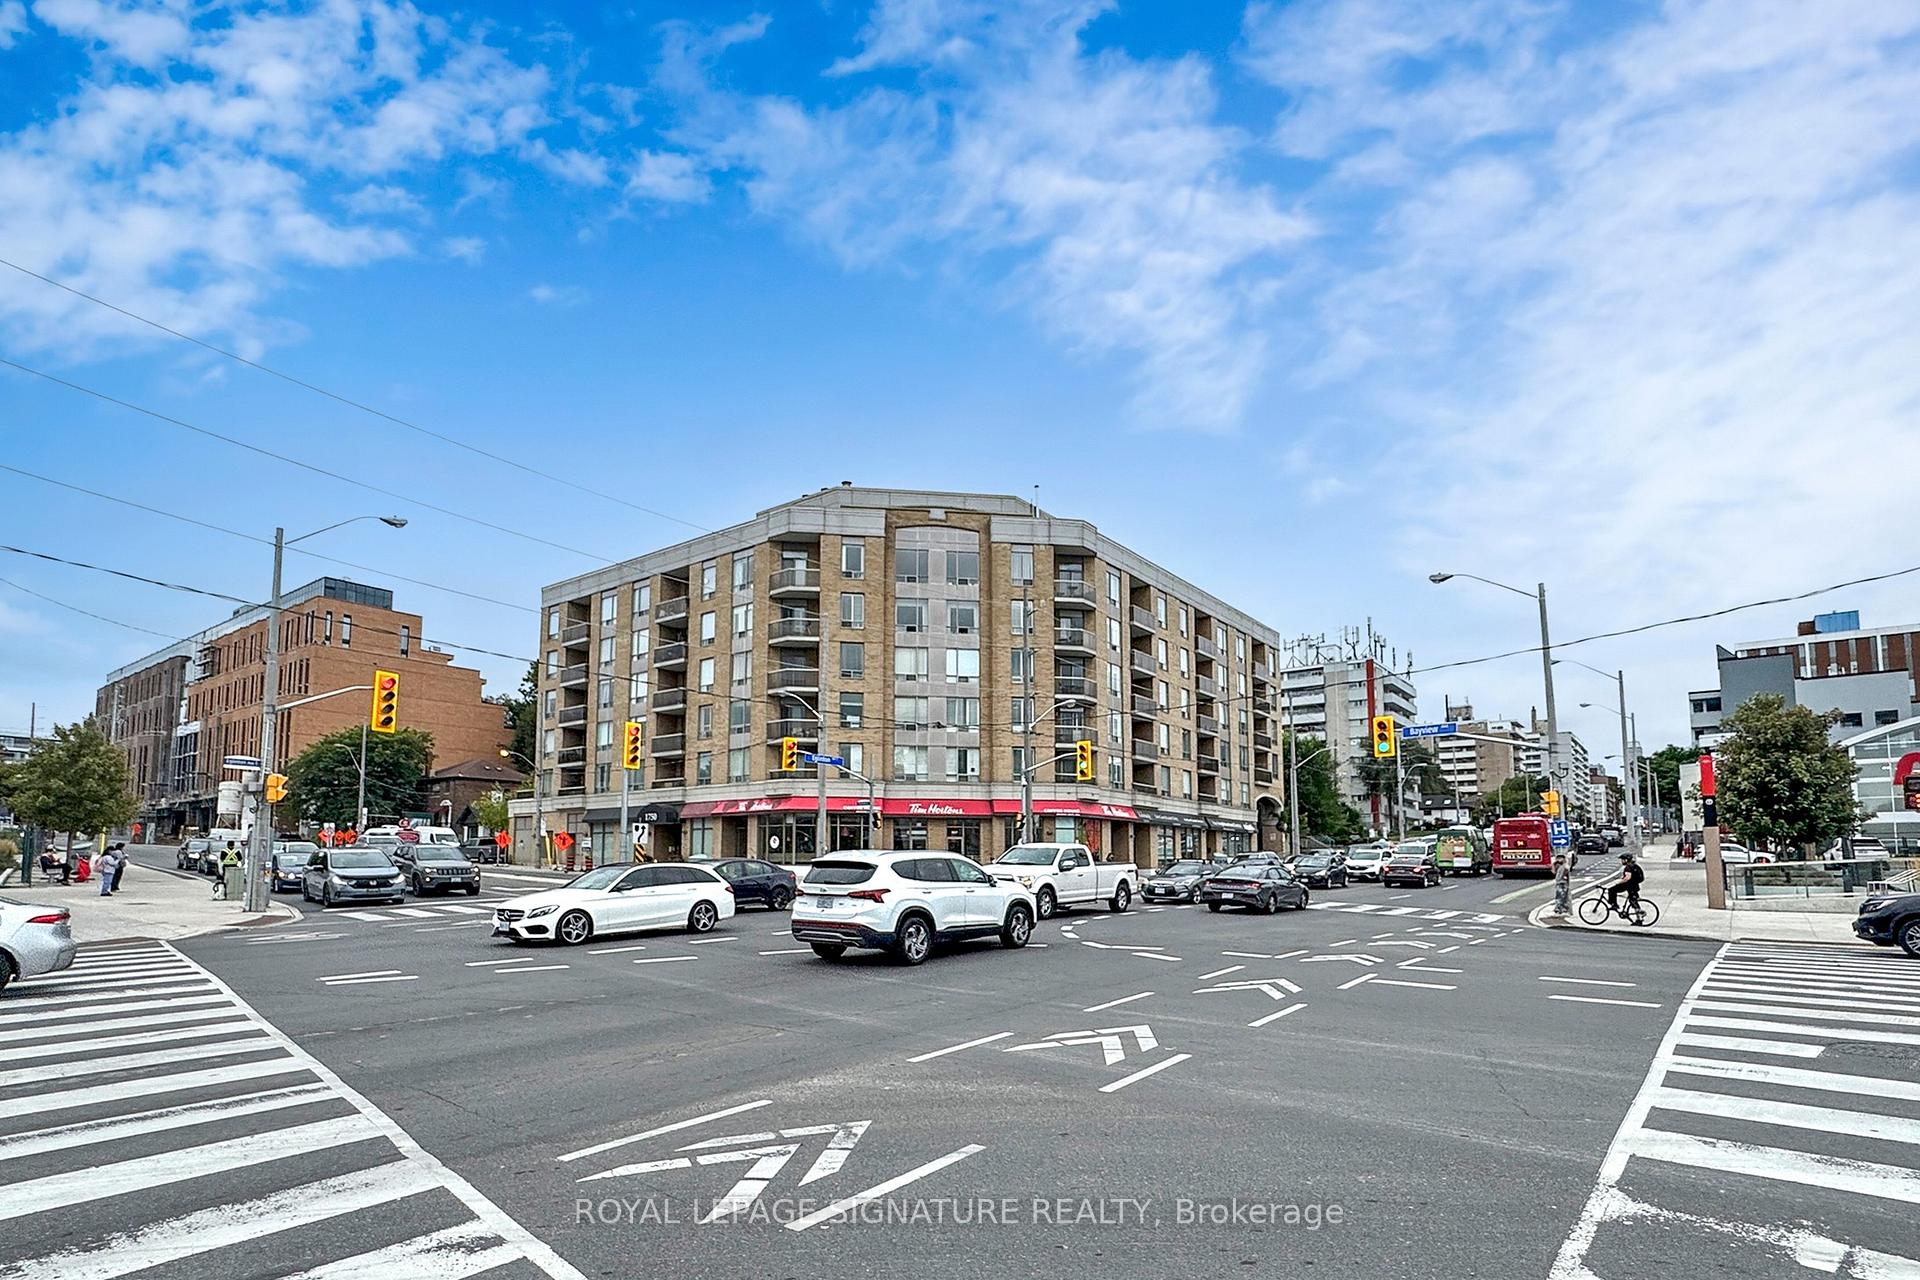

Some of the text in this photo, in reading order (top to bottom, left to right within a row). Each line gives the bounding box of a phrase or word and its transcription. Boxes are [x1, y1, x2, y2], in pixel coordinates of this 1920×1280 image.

[1410, 725, 1439, 736] Bayview
[909, 803, 963, 814] Tim Hortons
[1553, 822, 1566, 835] H
